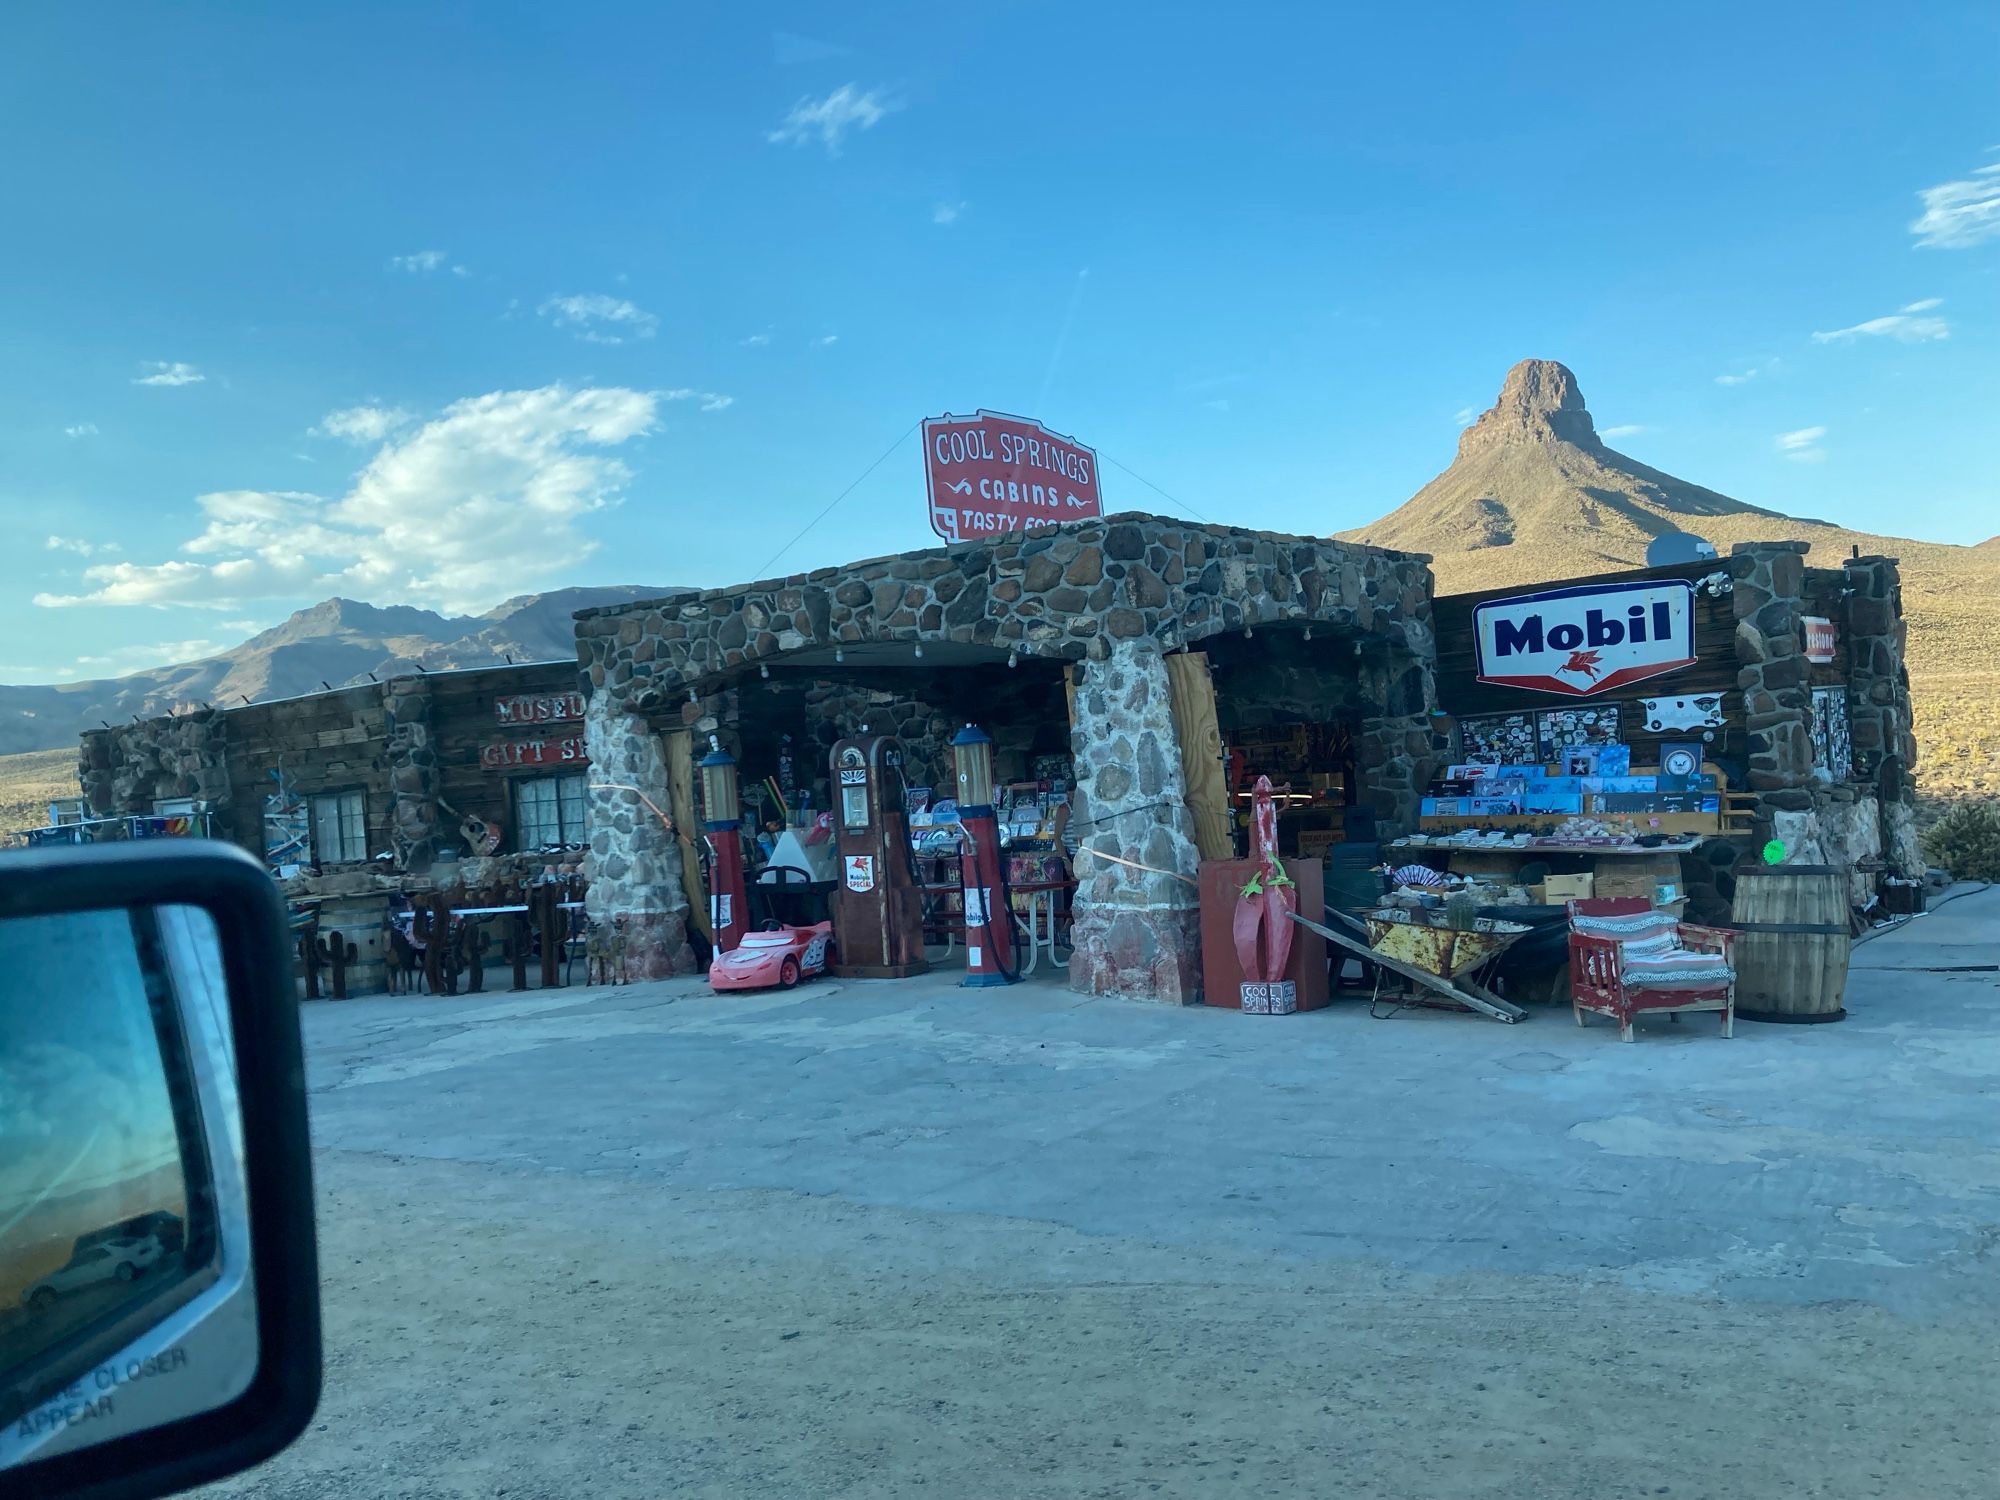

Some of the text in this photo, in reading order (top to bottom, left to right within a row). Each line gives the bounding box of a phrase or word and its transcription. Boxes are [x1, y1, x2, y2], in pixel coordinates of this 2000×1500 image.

[935, 430, 1089, 485] COOL SPRINGS
[979, 479, 1059, 507] CABINS
[962, 510, 1018, 531] TASTY
[1494, 601, 1672, 657] Mobil
[483, 741, 545, 765] GIFT
[1244, 997, 1280, 1007] SPRINGS
[1246, 987, 1275, 996] COOL
[95, 1347, 186, 1388] CLOSER
[18, 1394, 115, 1437] APPEAR
